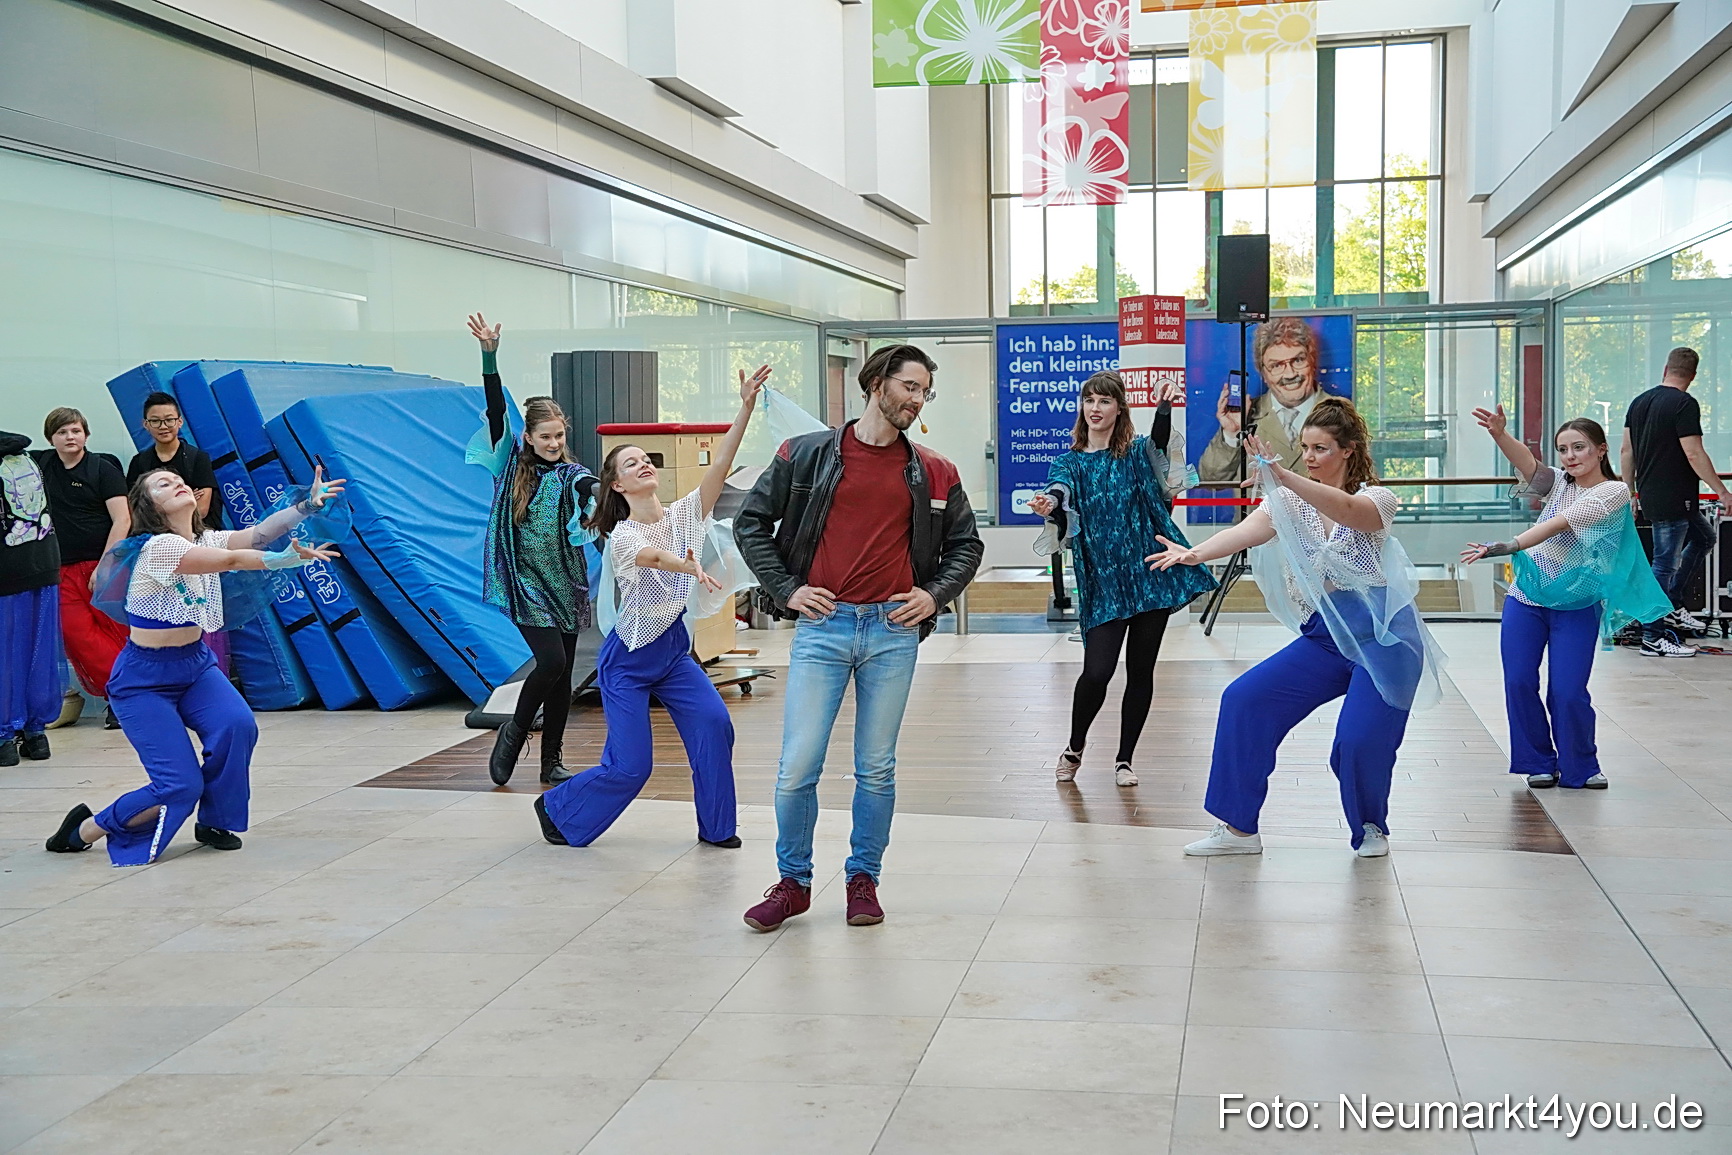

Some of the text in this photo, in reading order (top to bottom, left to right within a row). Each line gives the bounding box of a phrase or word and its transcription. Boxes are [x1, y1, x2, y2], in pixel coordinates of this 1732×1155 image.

[1009, 334, 1115, 352] Ich hab ihn:
[1009, 355, 1120, 373] den kleinste
[1009, 376, 1086, 393] Fernseh
[1120, 370, 1148, 389] REWE
[1009, 396, 1080, 413] der Wel
[1124, 391, 1148, 404] ENTER
[1011, 428, 1026, 437] Mit
[1028, 428, 1048, 437] HD+
[1011, 440, 1070, 450] Fernsehen in
